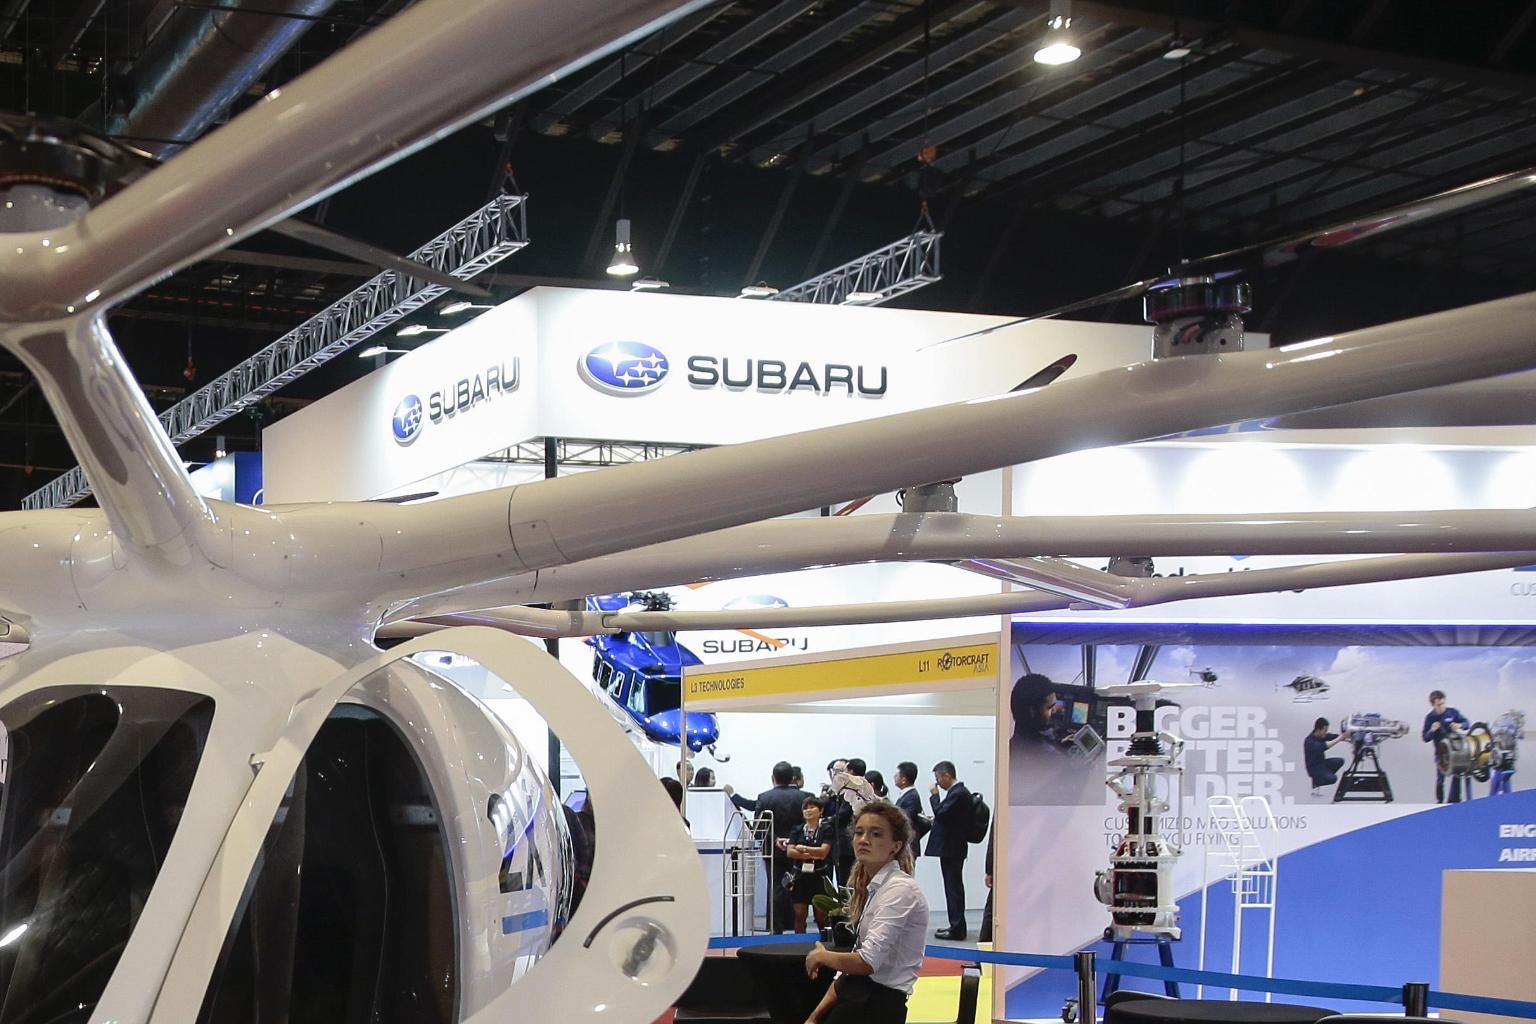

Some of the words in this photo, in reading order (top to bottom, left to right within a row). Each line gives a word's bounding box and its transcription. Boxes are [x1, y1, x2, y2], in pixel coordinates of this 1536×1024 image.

[429, 356, 519, 421] SUBARU
[687, 355, 887, 395] SUBARU
[918, 660, 930, 673] L11
[699, 677, 745, 692] TECHNOLOGIES
[1106, 706, 1278, 738] BGGER.
[1106, 740, 1295, 772] BTER.
[1106, 774, 1295, 805] LDER.
[1498, 848, 1536, 862] AIR
